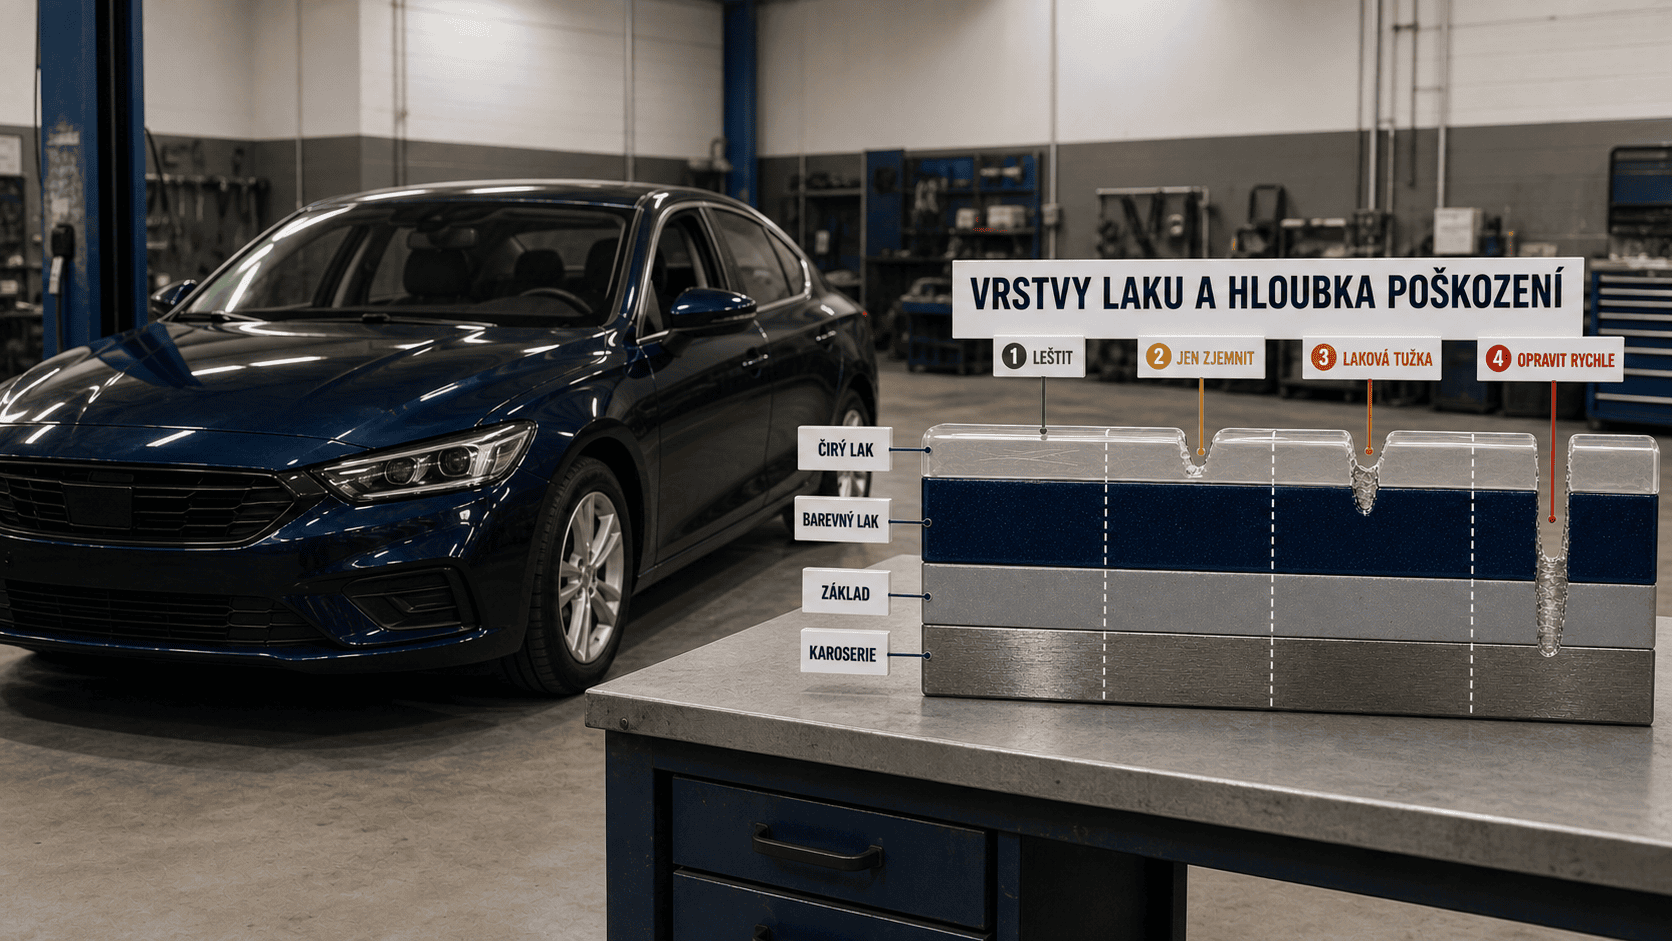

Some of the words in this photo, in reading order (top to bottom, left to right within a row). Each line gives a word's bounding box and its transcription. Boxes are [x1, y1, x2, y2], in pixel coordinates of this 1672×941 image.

[969, 276, 1092, 311] VRSTVY
[1103, 275, 1184, 310] LAKU
[1194, 275, 1217, 310] A
[1228, 274, 1377, 310] HLOUBKA
[1387, 265, 1565, 310] POŠKOZENÍ
[1010, 348, 1018, 365] 1
[1033, 347, 1074, 365] LEŠTIT
[1153, 348, 1165, 365] 2
[1176, 350, 1199, 366] JEN
[1203, 350, 1255, 366] ZJEMNIT
[1318, 348, 1329, 366] 3
[1343, 348, 1390, 366] LAKOVÁ
[1393, 348, 1433, 367] TUŽKA
[1492, 350, 1504, 367] 4
[1517, 352, 1567, 368] OPRAVIT
[1570, 352, 1616, 368] RYCHLE
[817, 439, 847, 458] ČIRÝ
[849, 442, 874, 458] LAK
[802, 511, 854, 529] BAREVNÝ
[857, 513, 880, 529] LAK
[821, 582, 871, 602] ZÁKLAD
[809, 644, 877, 663] KAROSERIE
